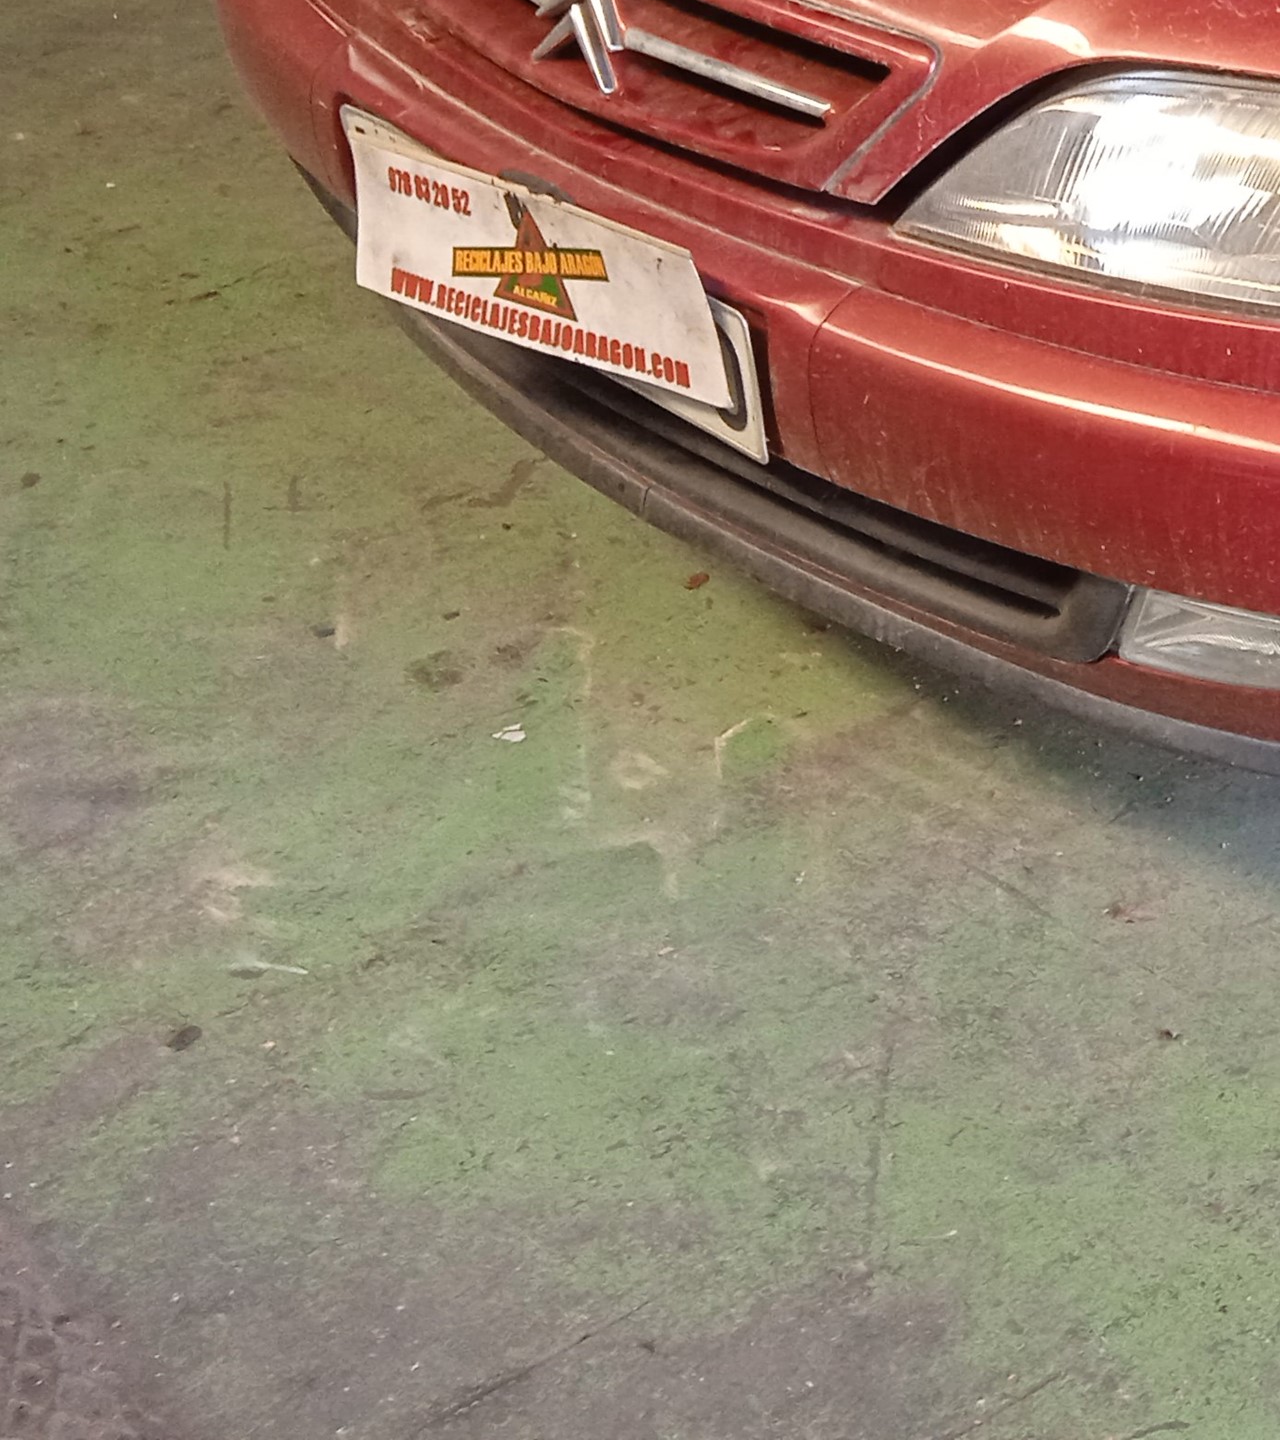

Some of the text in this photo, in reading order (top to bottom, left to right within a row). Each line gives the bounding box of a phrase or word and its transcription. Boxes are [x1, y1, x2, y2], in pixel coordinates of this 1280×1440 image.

[432, 180, 450, 210] 20
[451, 186, 472, 217] 52
[455, 249, 523, 274] RECICLAJES
[525, 251, 558, 275] BAJO
[391, 267, 691, 389] WWW.RECICLAJESBAJOARAGON.COM
